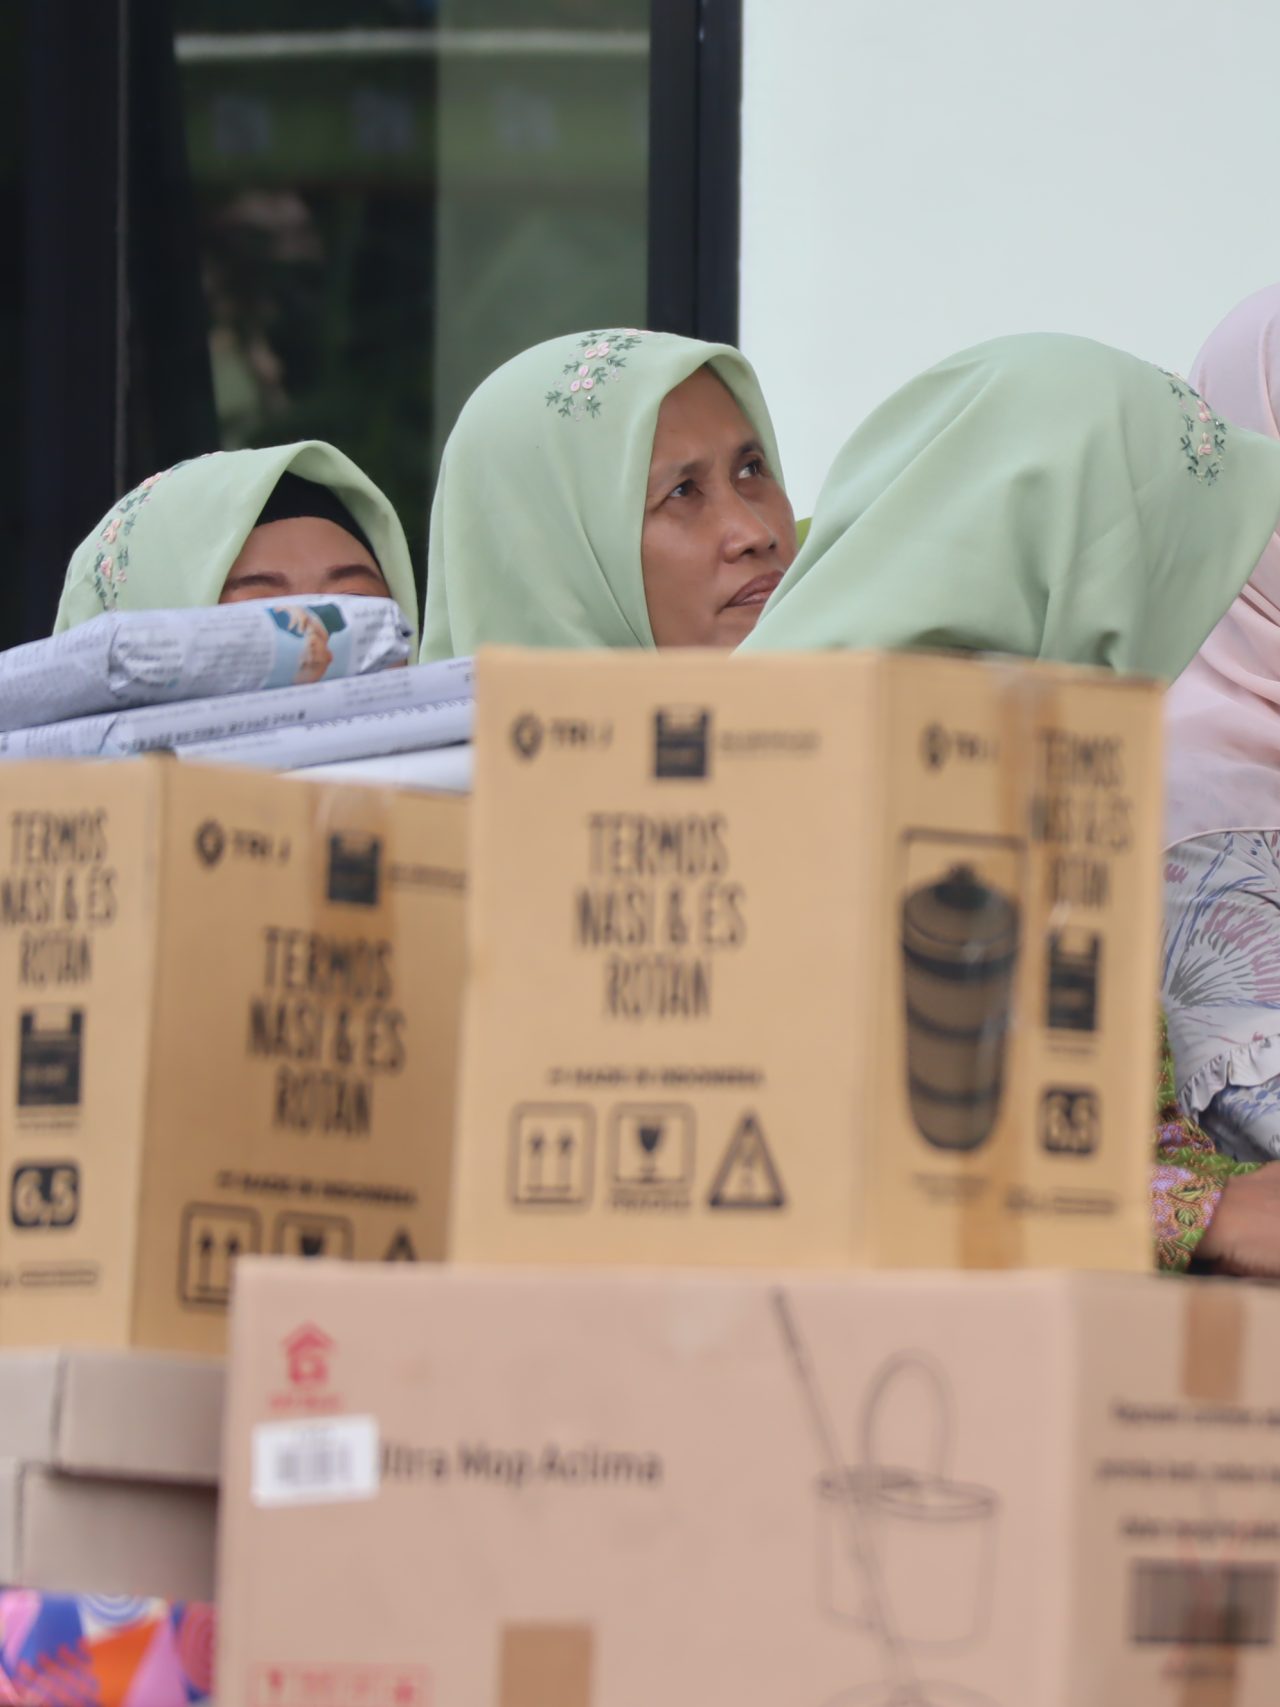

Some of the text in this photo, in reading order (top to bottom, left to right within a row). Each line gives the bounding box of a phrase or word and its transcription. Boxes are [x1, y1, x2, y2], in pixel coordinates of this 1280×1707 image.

[10, 808, 108, 866] TERMOS
[587, 812, 729, 878] TERMOS
[87, 867, 118, 928] ES
[576, 883, 657, 949] NASI
[702, 879, 747, 951] ES
[18, 928, 94, 986] ROTAN
[262, 926, 394, 1000] TERMOS
[605, 951, 711, 1020] ROTAN
[247, 1000, 325, 1061] NASI
[365, 1004, 406, 1074] ES
[273, 1062, 373, 1138] ROTAN
[457, 1440, 530, 1488] Mop
